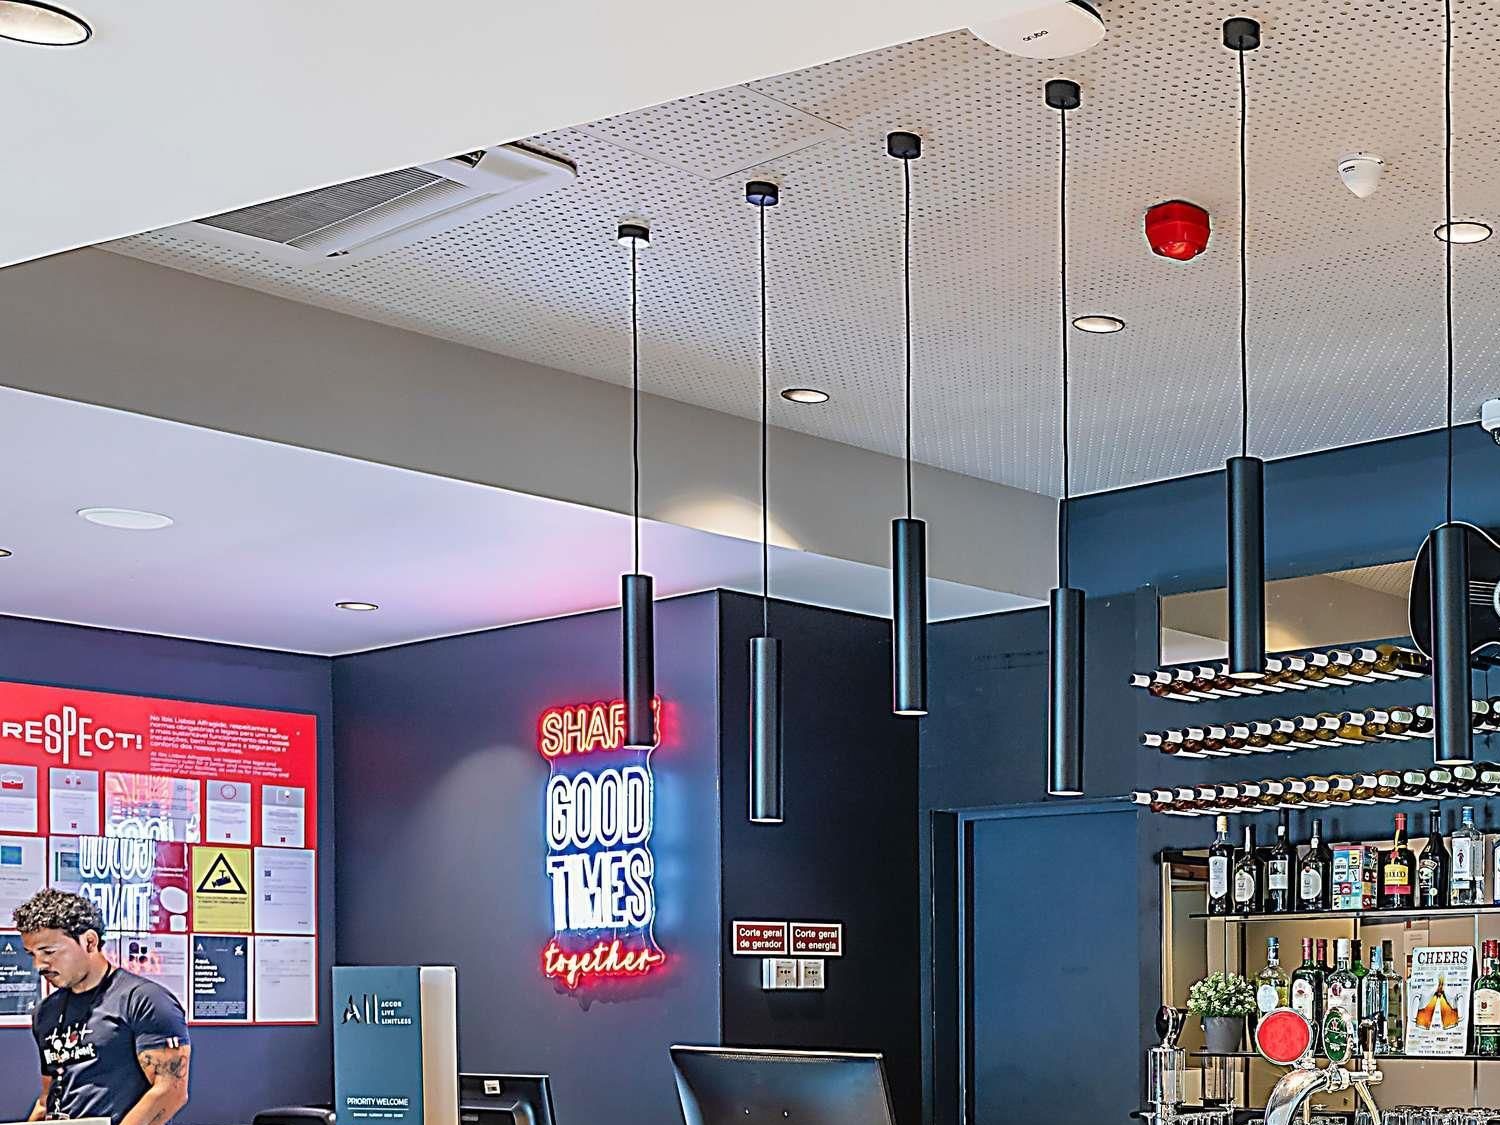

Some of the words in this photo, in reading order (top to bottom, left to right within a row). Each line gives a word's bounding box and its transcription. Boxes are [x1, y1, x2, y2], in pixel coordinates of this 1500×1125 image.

[2, 705, 142, 764] RESPECT!
[548, 767, 649, 848] GOOD
[547, 851, 653, 930] TIMES
[740, 928, 760, 936] Corte
[763, 929, 782, 938] geral
[795, 928, 816, 938] Corte
[818, 930, 837, 940] geral
[752, 940, 782, 949] gerador
[796, 941, 806, 949] de
[808, 942, 836, 951] energia
[545, 941, 658, 987] together
[1418, 951, 1468, 964] CHEERS
